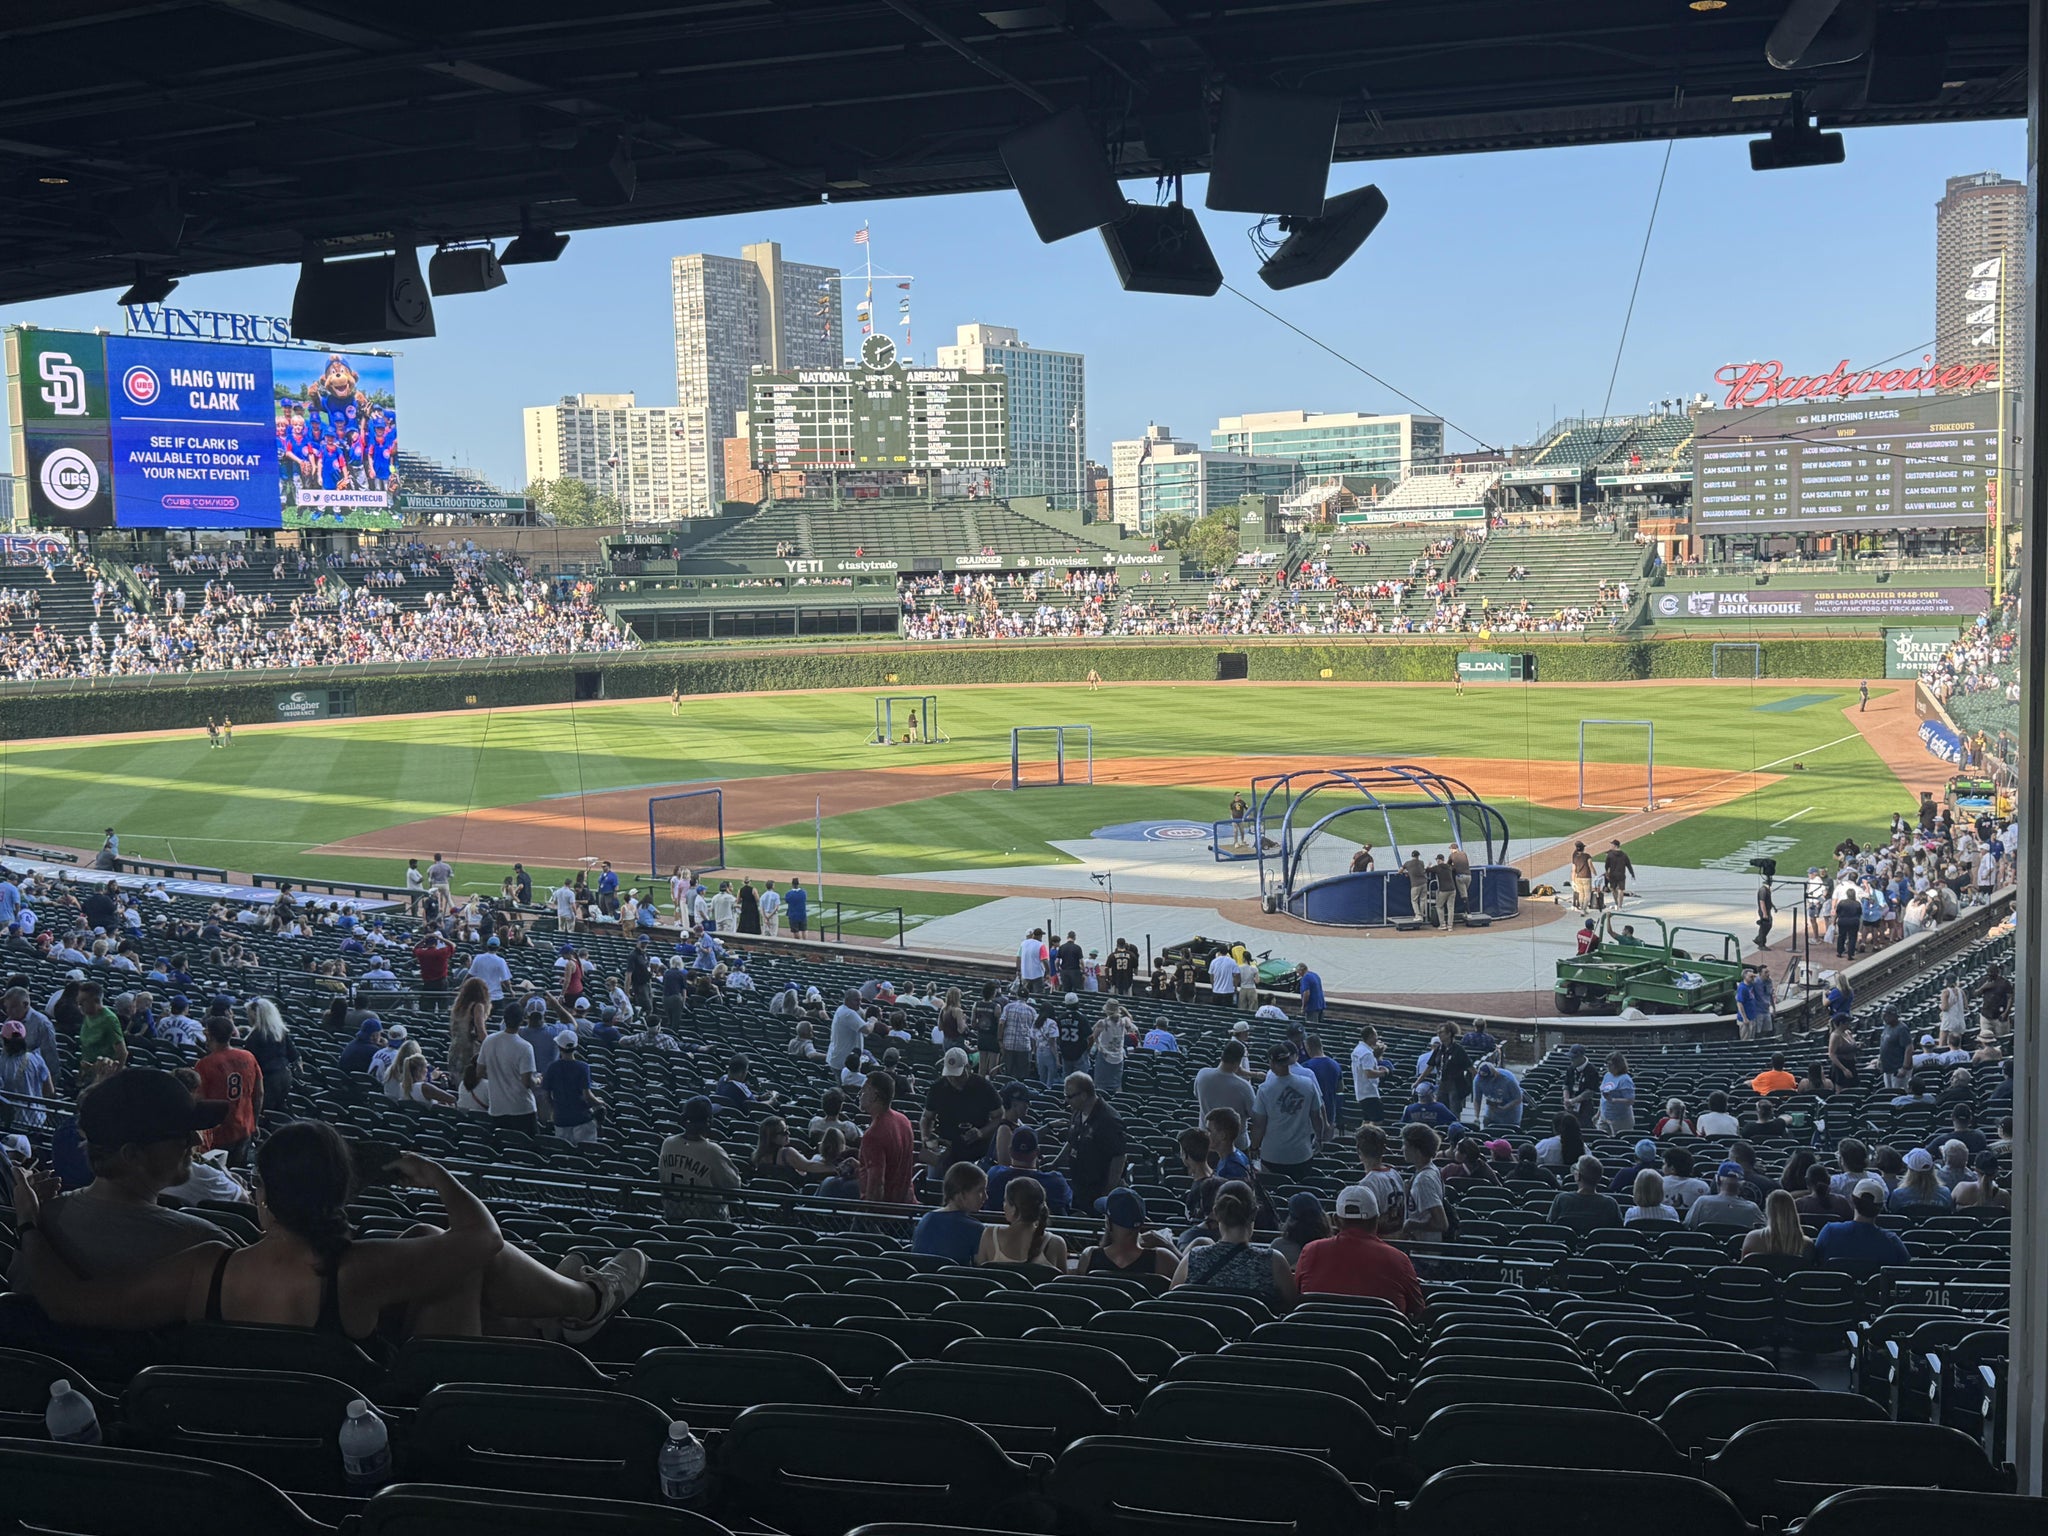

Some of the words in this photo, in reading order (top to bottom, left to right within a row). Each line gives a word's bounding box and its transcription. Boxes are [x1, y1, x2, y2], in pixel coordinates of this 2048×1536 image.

[170, 368, 213, 388] HANG
[216, 372, 255, 390] WITH
[799, 372, 853, 383] NATIONAL
[906, 371, 959, 382] AMERICAN
[1714, 354, 1996, 409] Budweiser
[189, 391, 239, 411] CLARK
[1811, 414, 1827, 423] MLB
[1828, 411, 1863, 422] PITCHING
[1929, 422, 1975, 432] STRIKEOUTS
[1837, 429, 1857, 438] WHIP
[151, 436, 172, 448] SEE
[175, 437, 185, 448] IF
[187, 438, 227, 449] CLARK
[228, 439, 239, 450] IS
[1876, 443, 1891, 451] 0.77
[129, 451, 193, 464] AVAILABLE
[195, 453, 210, 465] TO
[214, 454, 245, 465] BOOK
[246, 455, 261, 466] AT
[142, 468, 180, 479] YOUR
[182, 469, 208, 480] NEXT
[210, 470, 250, 481] EVENT!
[1703, 467, 1717, 475] CAM
[1816, 490, 1852, 498] SCHLITTLER
[1905, 487, 1919, 495] CAM
[1961, 485, 1976, 493] NYY
[324, 494, 383, 503] @CLARKTHECUB
[407, 495, 508, 508] WRIGLEYROOFTOPS.COM
[1801, 506, 1818, 514] PAUL
[1905, 502, 1926, 510] GAVIN
[1926, 502, 1957, 510] WILLIAMS
[634, 535, 663, 545] Mobile
[1117, 554, 1164, 564] Advocate
[784, 560, 823, 573] YETI
[845, 560, 898, 572] tastytrade
[1719, 593, 1749, 603] JACK
[1814, 592, 1835, 600] CUBS
[1718, 603, 1802, 614] BRICKHOUSE
[1897, 642, 1949, 654] DRAFT
[1458, 662, 1504, 671] SLOAN
[278, 701, 320, 711] Gallagher
[1061, 1027, 1080, 1042] 23
[227, 1072, 242, 1101] 8
[662, 1154, 709, 1178] HOFFMAN
[1501, 1268, 1524, 1286] 215
[1925, 1290, 1950, 1307] 216
